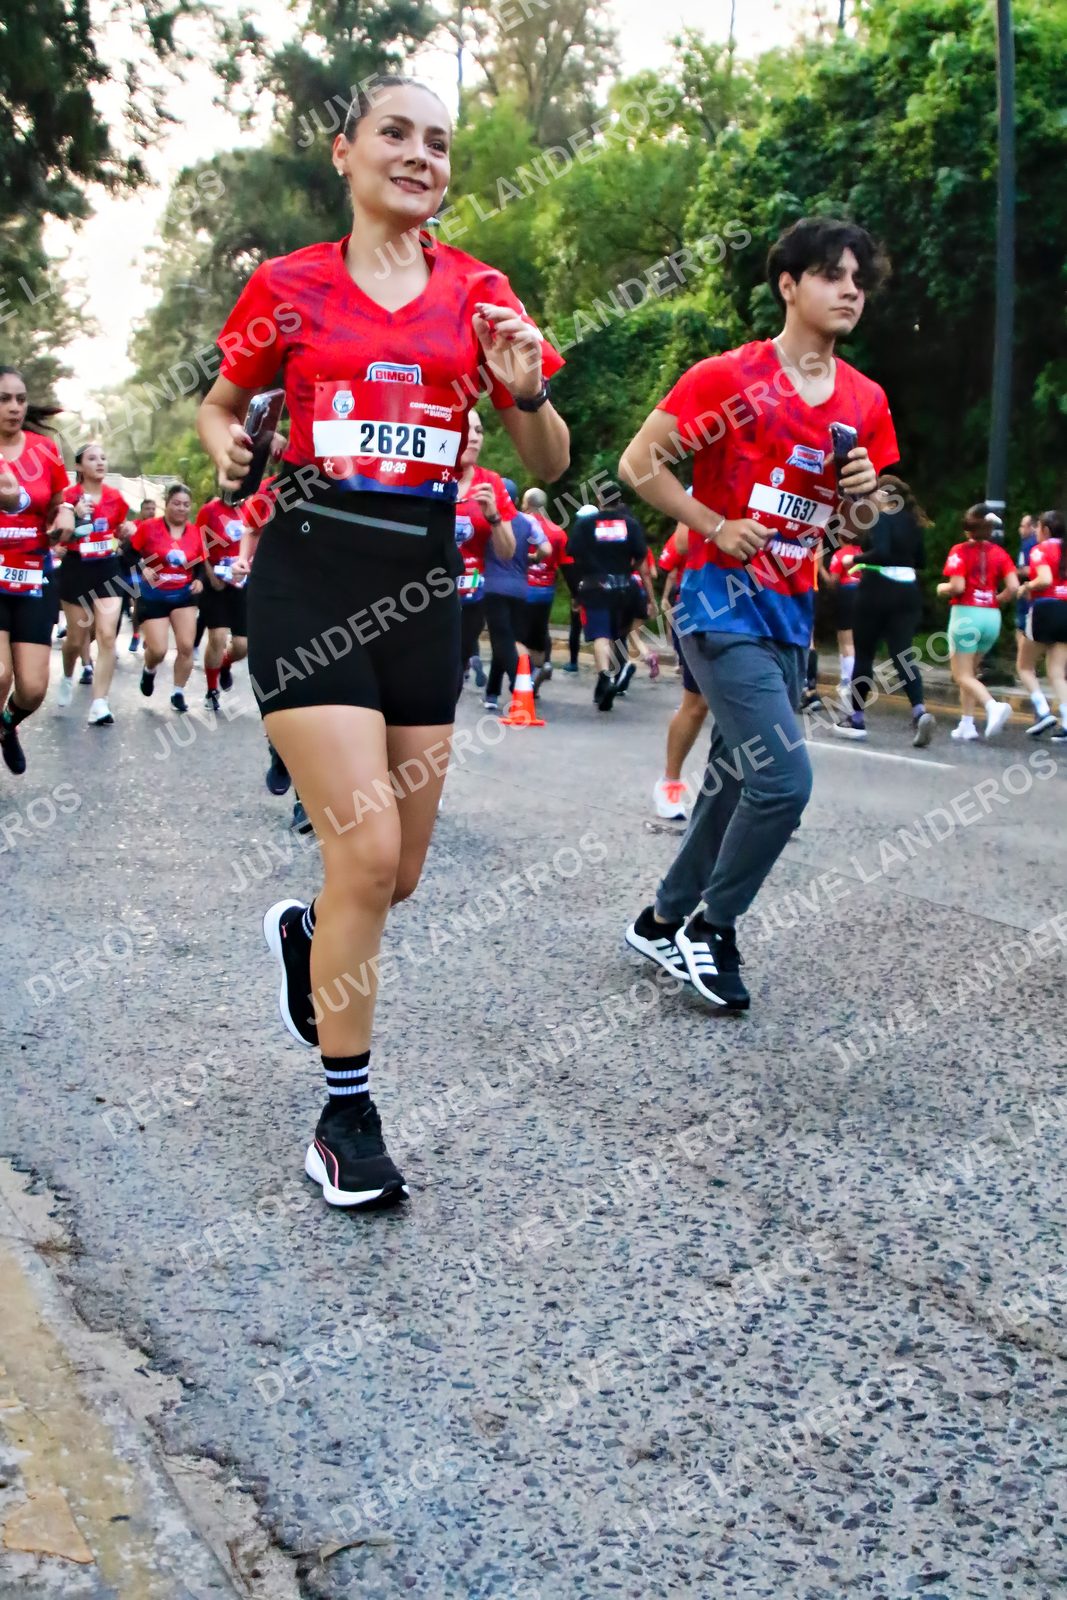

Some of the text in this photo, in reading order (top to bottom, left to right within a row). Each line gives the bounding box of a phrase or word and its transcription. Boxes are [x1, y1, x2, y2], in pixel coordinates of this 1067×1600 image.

[375, 369, 415, 382] BIMBO
[360, 423, 426, 458] 2626
[777, 492, 818, 522] 17637
[4, 567, 28, 582] 2981
